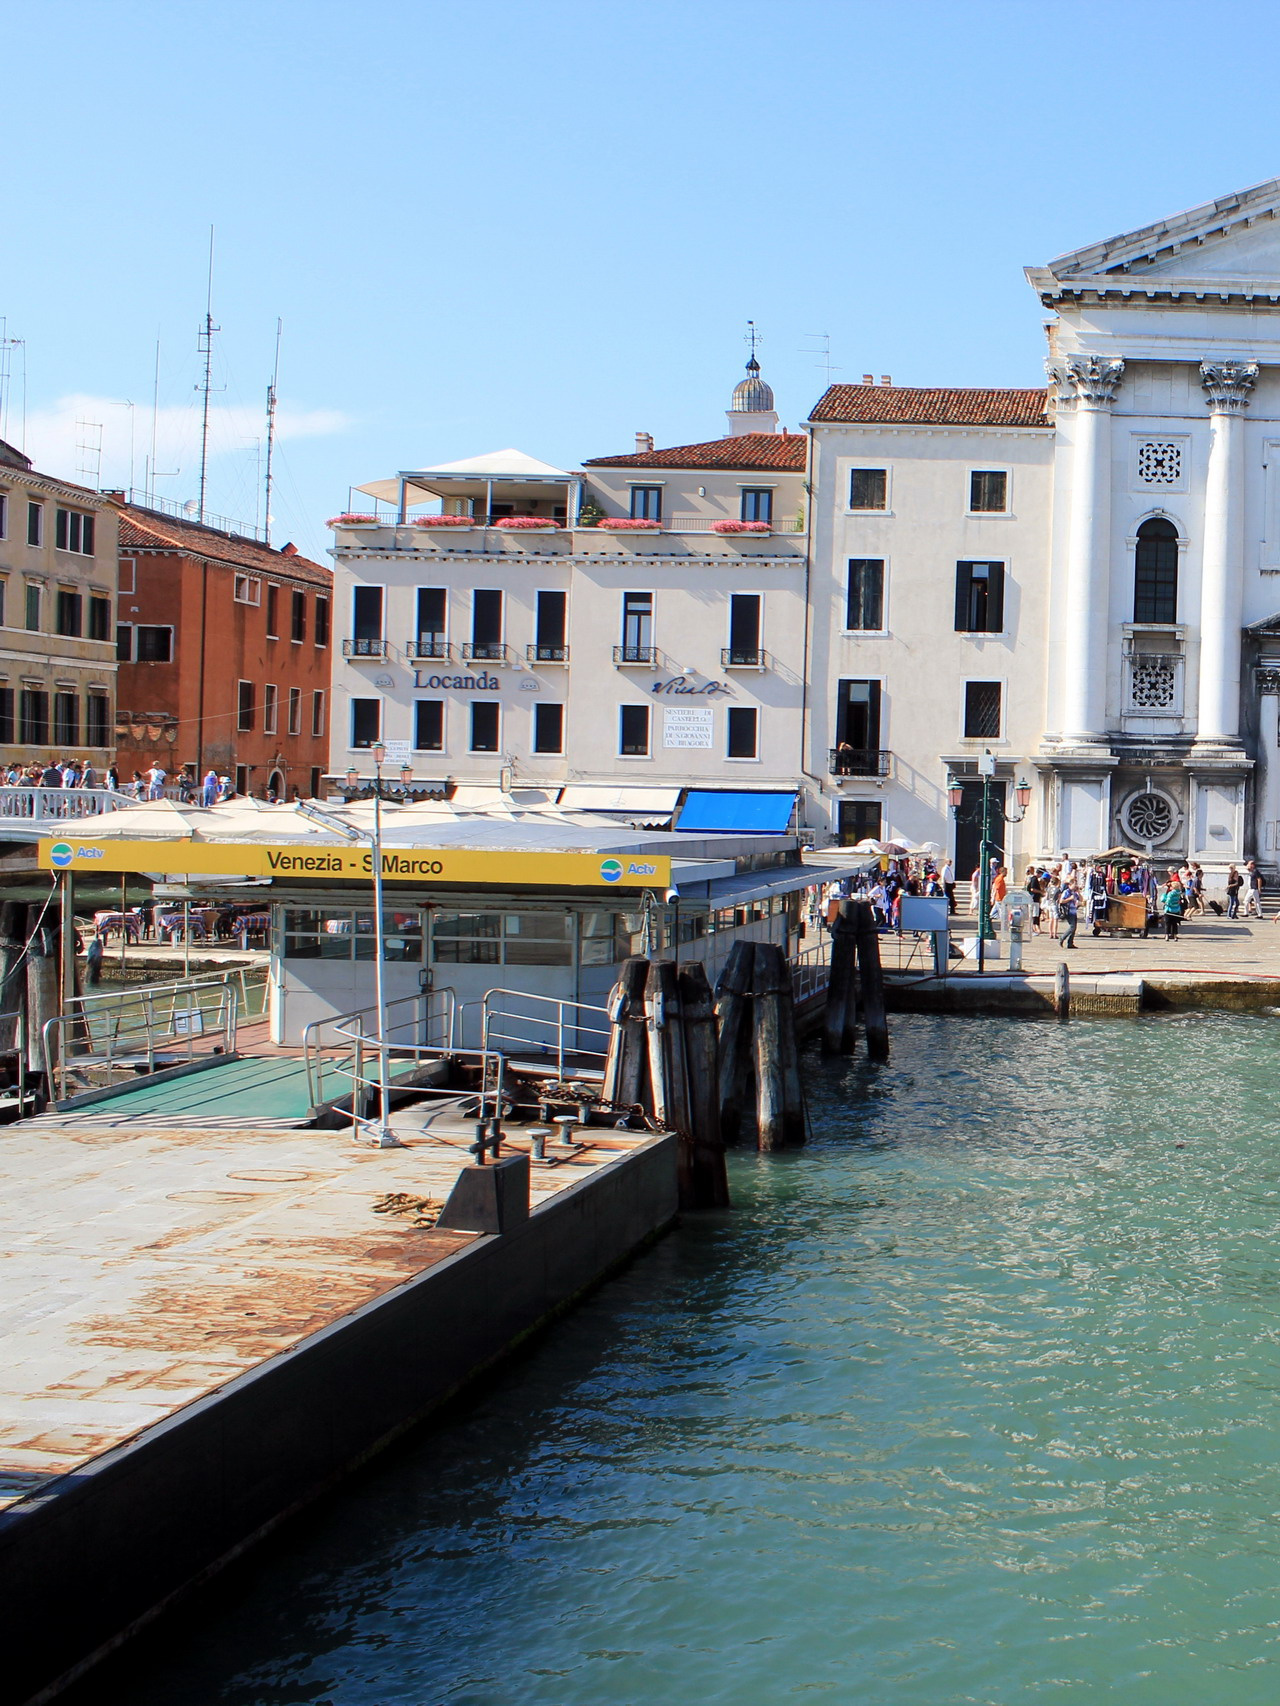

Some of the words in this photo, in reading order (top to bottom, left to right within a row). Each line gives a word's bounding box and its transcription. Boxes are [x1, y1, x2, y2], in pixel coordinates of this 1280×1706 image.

[413, 669, 500, 690] Locanda
[76, 846, 105, 859] Actv
[267, 851, 343, 872] Venezia
[382, 854, 443, 874] Marco
[627, 863, 656, 875] Actv
